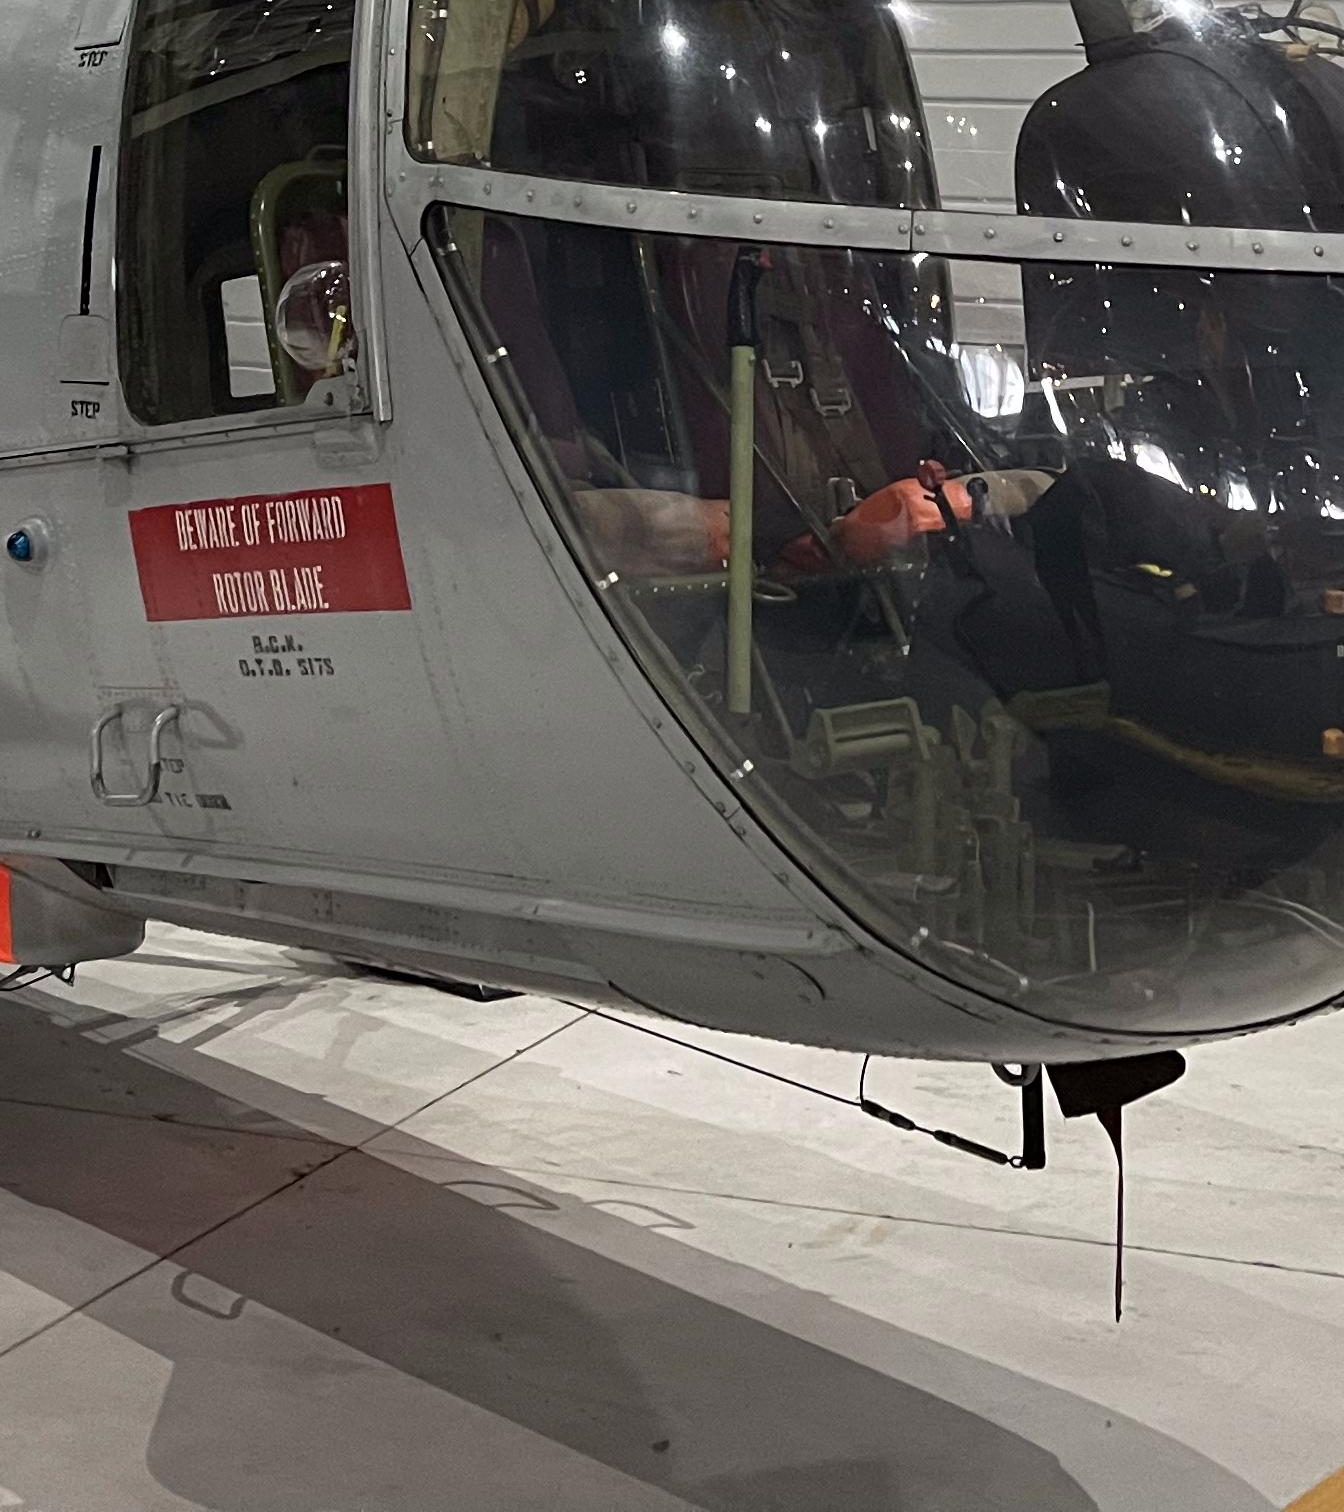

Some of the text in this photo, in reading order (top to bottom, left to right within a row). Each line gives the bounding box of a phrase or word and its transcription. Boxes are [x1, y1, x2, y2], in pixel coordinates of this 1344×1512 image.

[71, 400, 101, 419] STEP
[175, 495, 346, 551] BEWARE OF FORWARD
[212, 565, 330, 614] ROTOR BLADE
